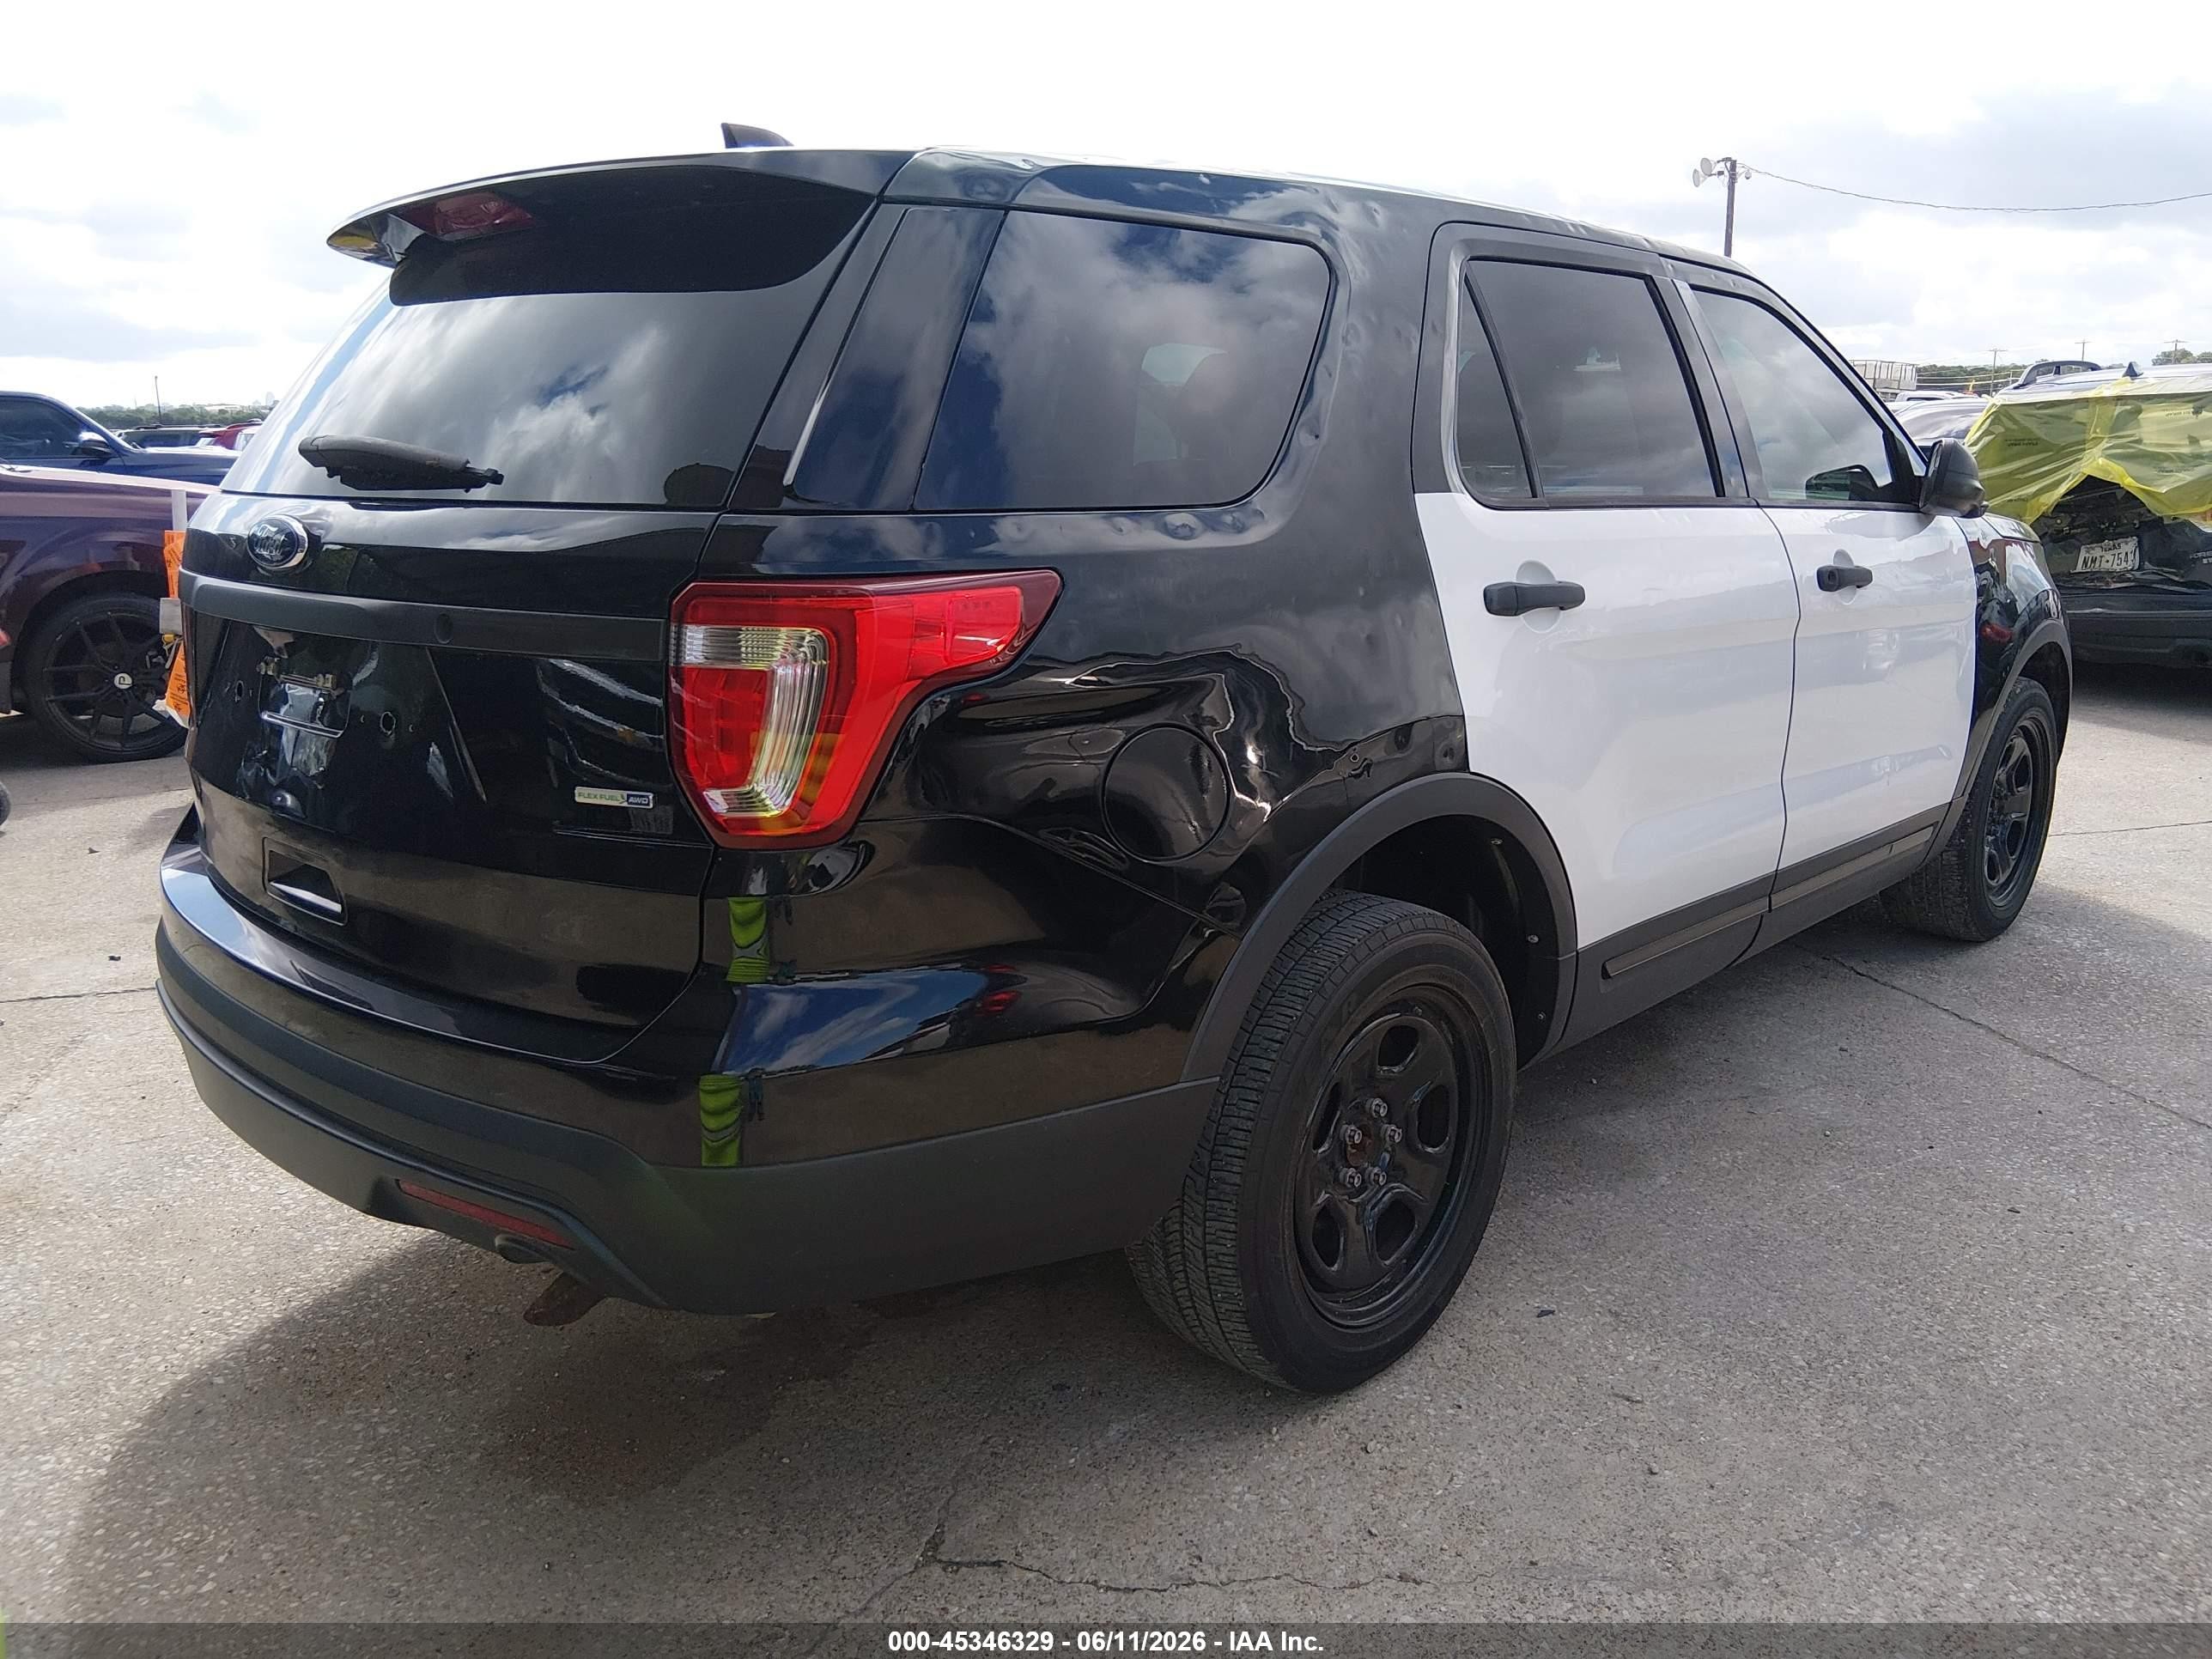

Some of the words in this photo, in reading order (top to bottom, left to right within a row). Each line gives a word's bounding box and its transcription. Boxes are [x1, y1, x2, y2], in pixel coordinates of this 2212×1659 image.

[578, 792, 598, 800] FLEX
[599, 793, 620, 802] FUEL
[628, 796, 649, 805] AWD
